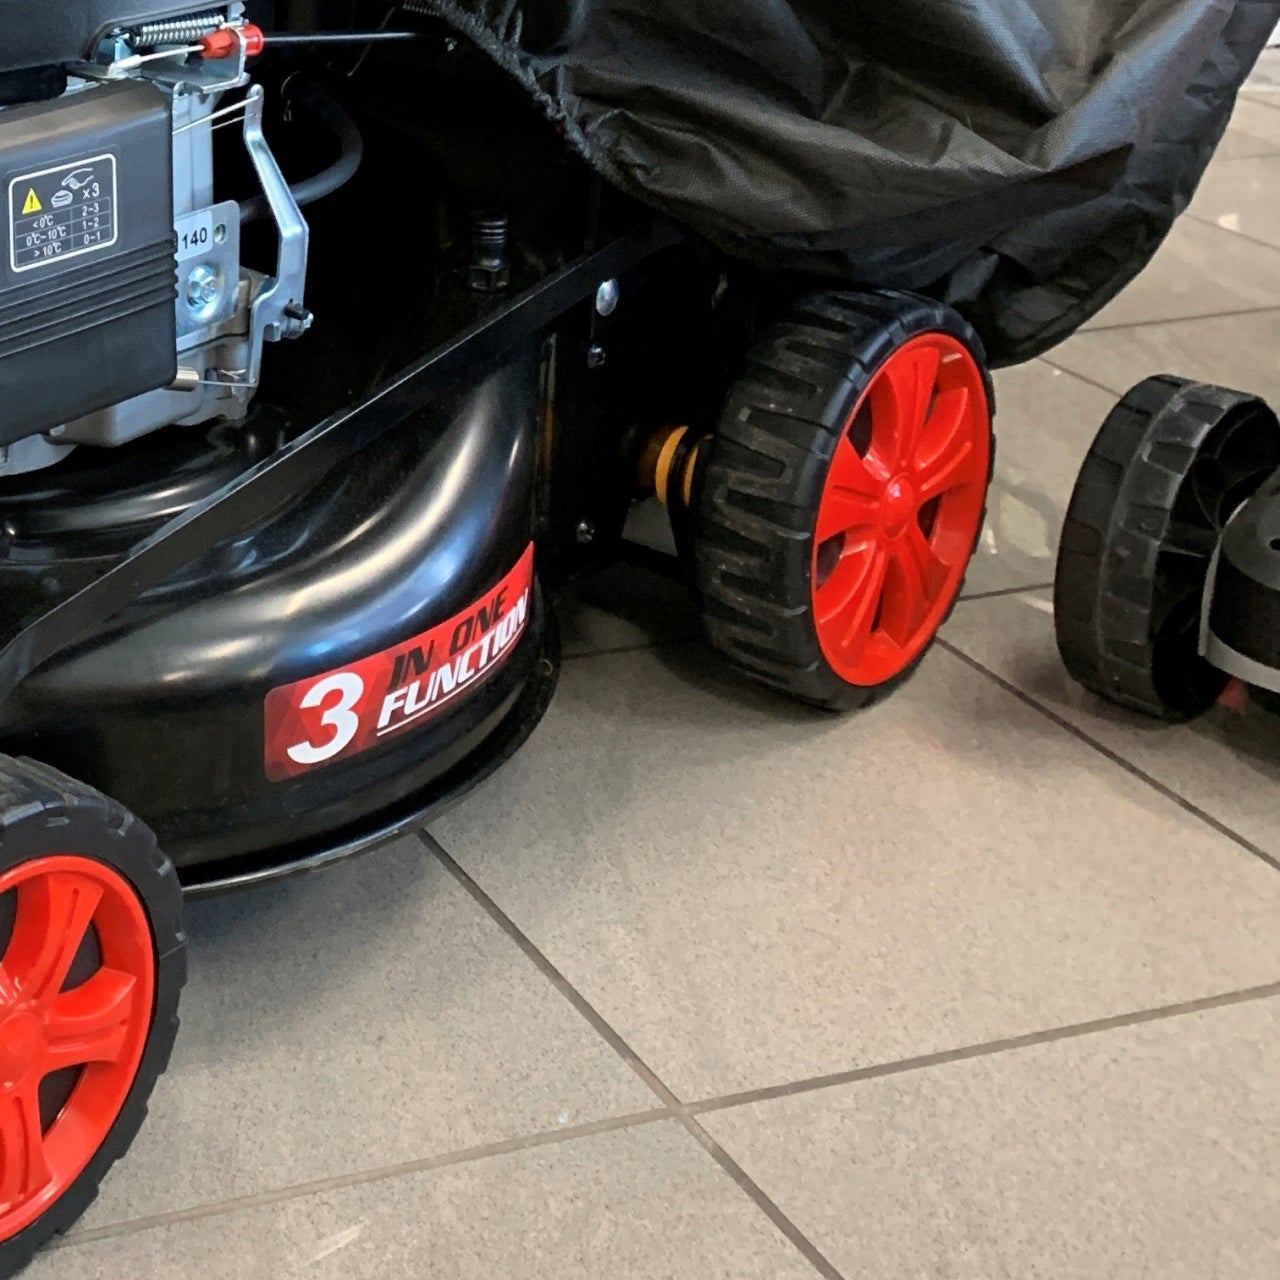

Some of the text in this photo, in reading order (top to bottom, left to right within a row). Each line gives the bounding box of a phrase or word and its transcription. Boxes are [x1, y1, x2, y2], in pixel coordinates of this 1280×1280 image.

[182, 227, 208, 250] 140
[377, 586, 529, 731] FUNCTION
[388, 585, 508, 691] IN ONE
[286, 671, 365, 765] 3
